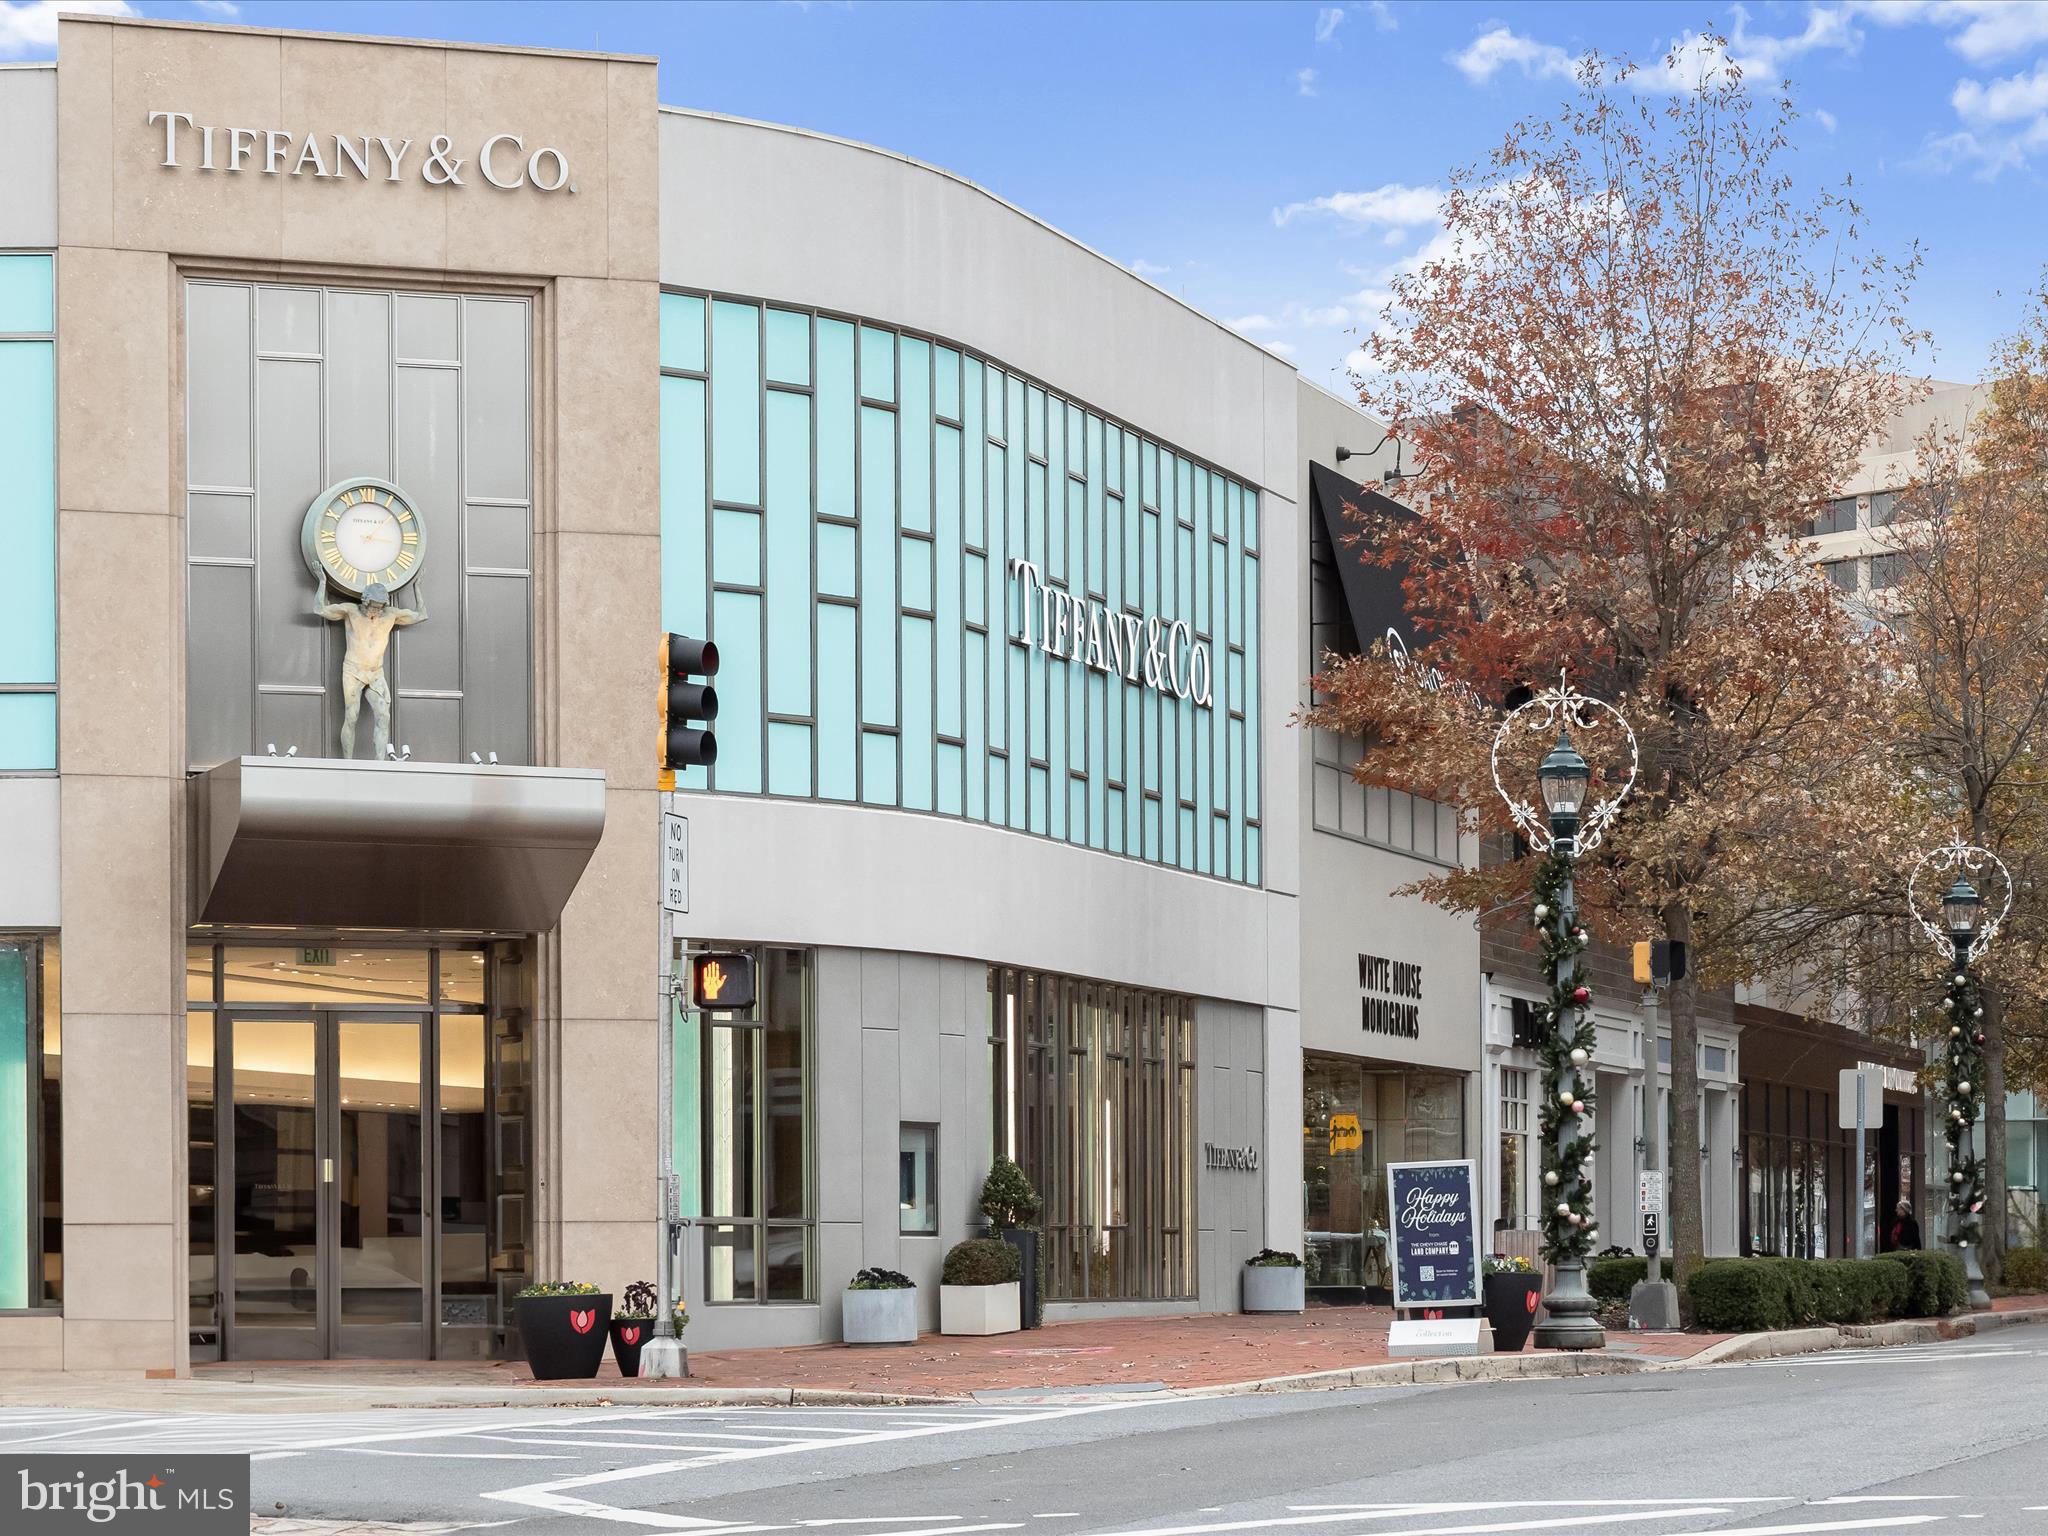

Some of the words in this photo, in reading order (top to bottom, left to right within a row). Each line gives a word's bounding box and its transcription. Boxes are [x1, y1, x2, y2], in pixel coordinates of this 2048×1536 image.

[421, 133, 467, 187] &
[1143, 614, 1167, 692] &
[671, 822, 682, 841] NO
[668, 845, 684, 863] TURN
[672, 867, 681, 883] ON
[669, 888, 682, 904] RED
[1358, 952, 1391, 994] WHYTE
[1392, 960, 1423, 1000] HOUSE
[1361, 996, 1420, 1041] MONOGRAMS
[1406, 1186, 1460, 1211] Happy
[1401, 1208, 1467, 1231] Holidays
